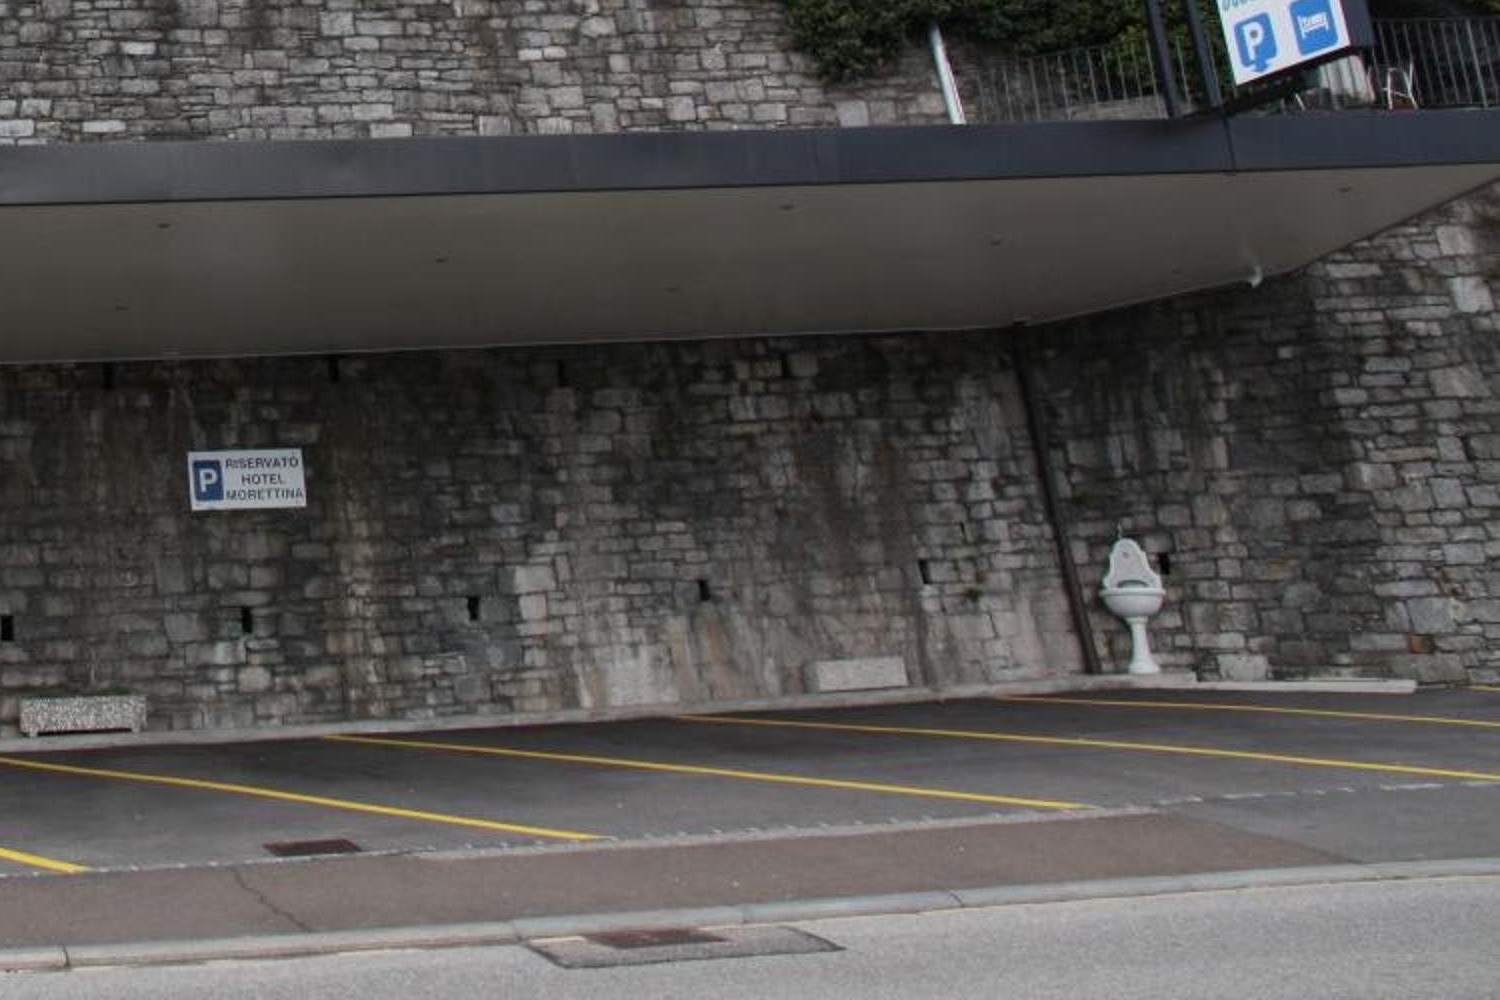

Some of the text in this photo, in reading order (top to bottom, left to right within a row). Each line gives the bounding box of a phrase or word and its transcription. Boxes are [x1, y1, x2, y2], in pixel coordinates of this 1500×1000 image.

[1242, 20, 1266, 61] P
[225, 456, 299, 469] RISERVATO
[198, 468, 219, 493] P
[241, 473, 283, 485] HOTEL
[226, 488, 303, 501] MORETTINA
